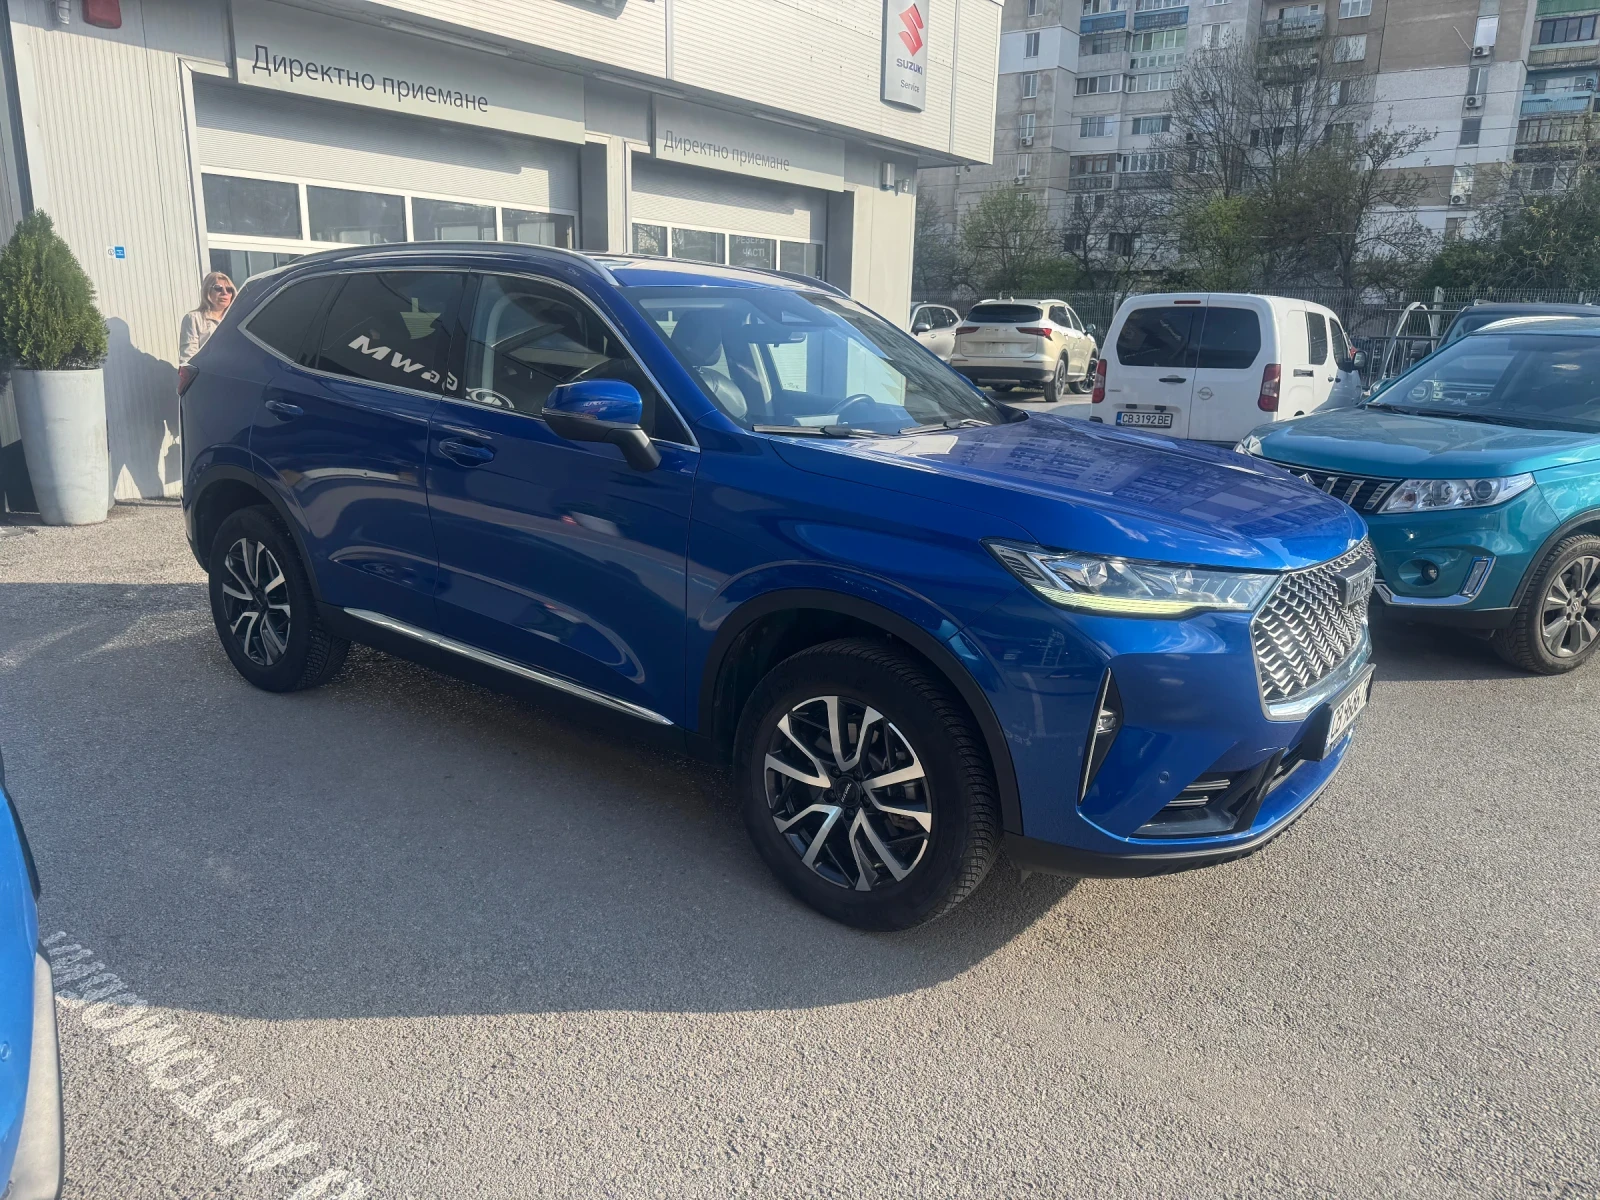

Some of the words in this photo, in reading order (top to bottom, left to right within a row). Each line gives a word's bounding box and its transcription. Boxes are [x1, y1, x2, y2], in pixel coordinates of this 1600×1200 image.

[896, 58, 923, 75] SUZUKI
[252, 44, 375, 91] Директно
[382, 76, 488, 113] приемане
[900, 79, 920, 93] Service
[663, 129, 729, 159] Директно
[732, 148, 790, 172] приемане
[1122, 413, 1134, 424] CB
[1134, 414, 1157, 424] 3192
[1157, 415, 1170, 425] BE
